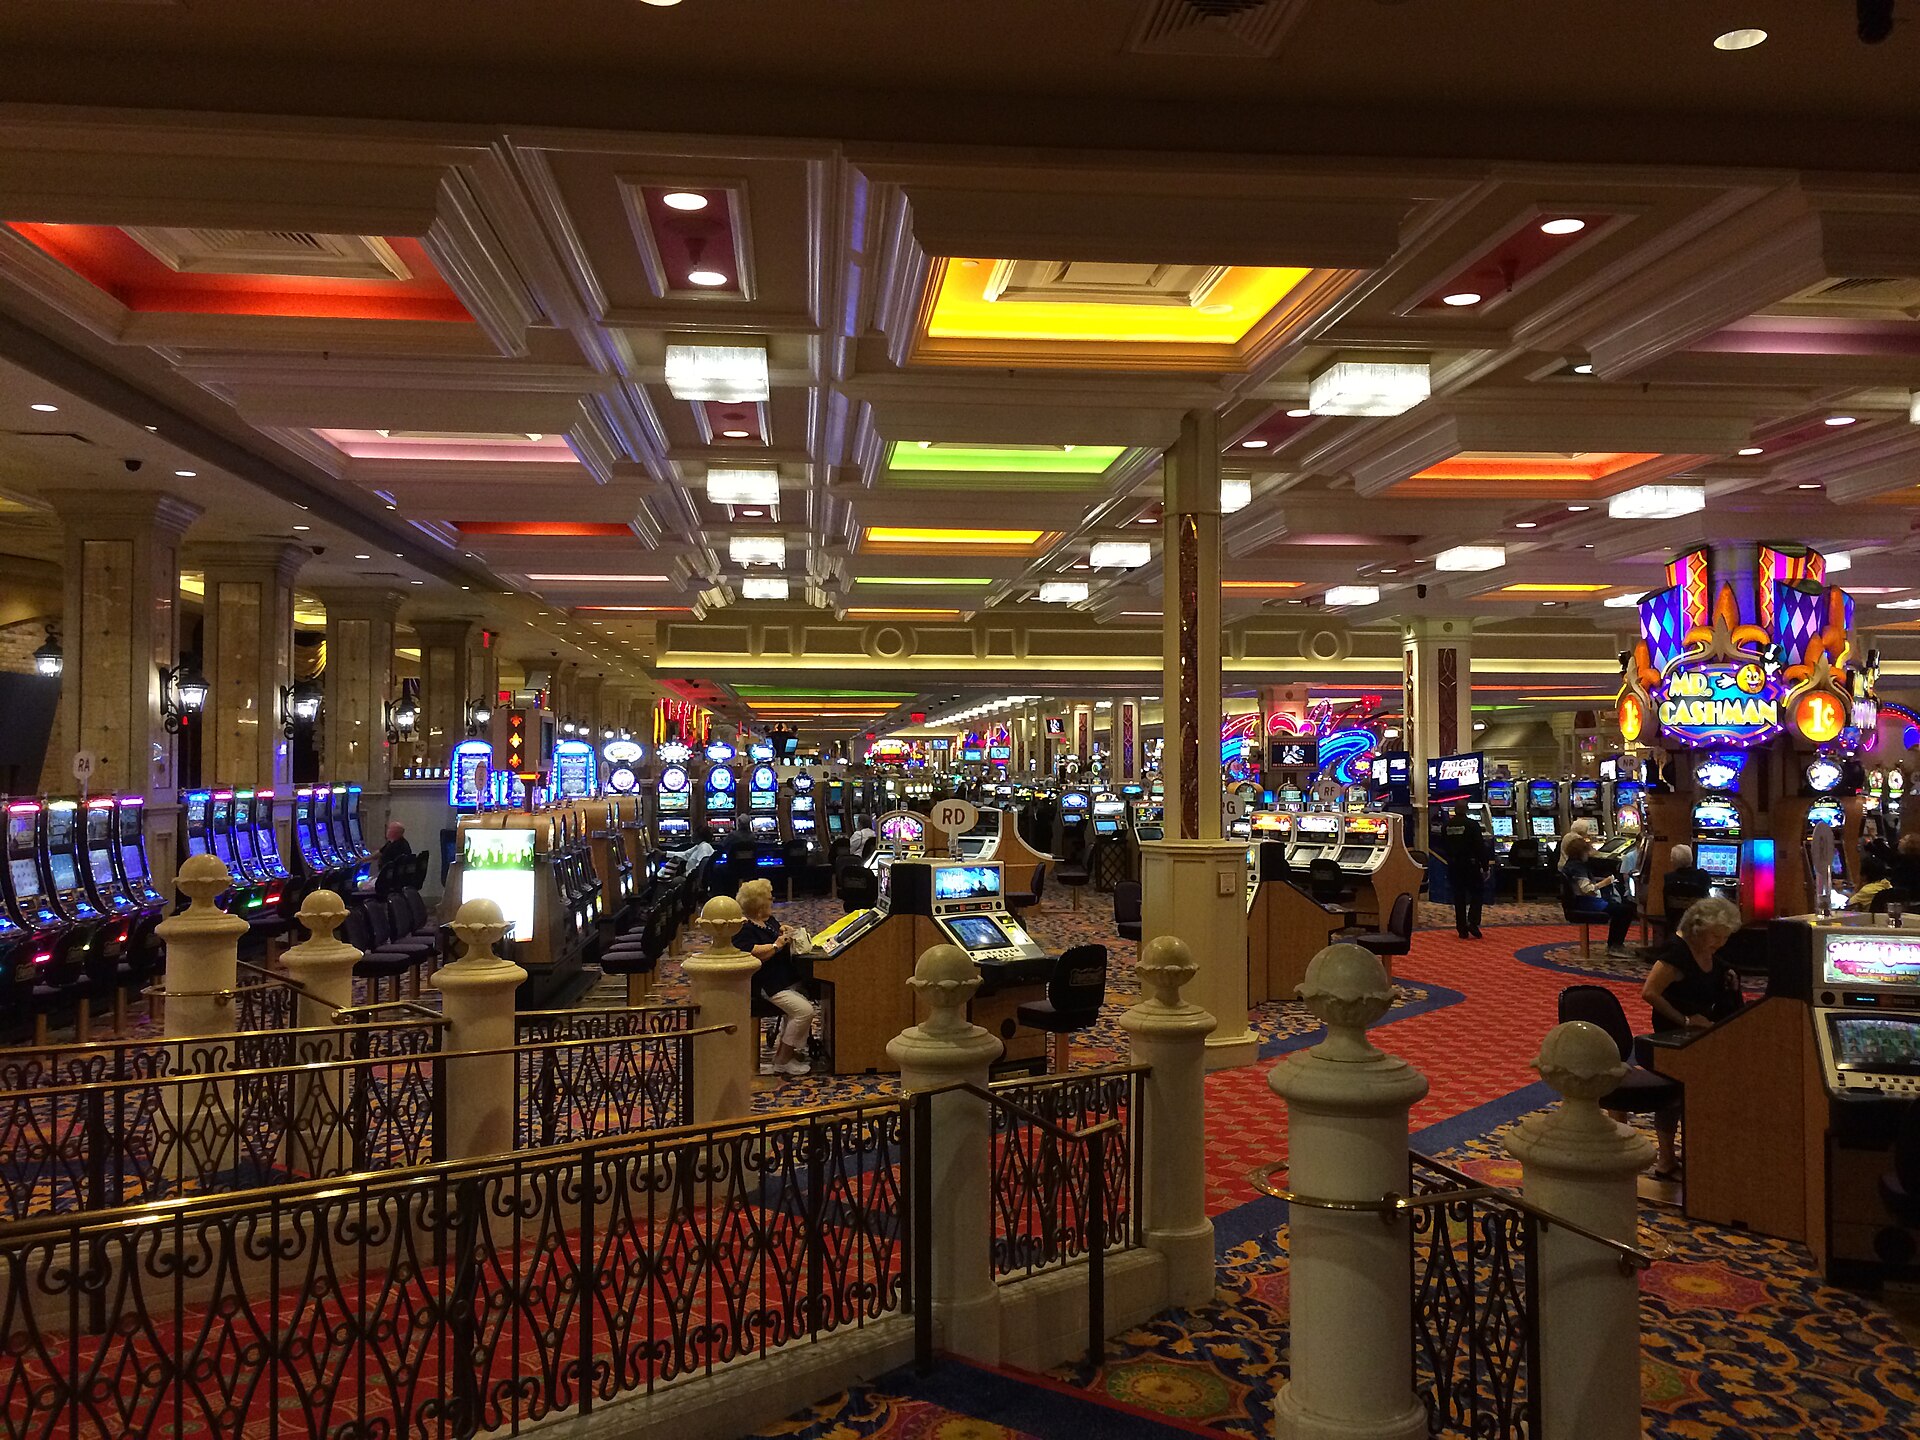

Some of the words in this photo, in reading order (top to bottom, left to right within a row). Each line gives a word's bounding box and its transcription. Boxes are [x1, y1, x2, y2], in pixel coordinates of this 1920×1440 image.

[1668, 671, 1714, 697] MR.
[1658, 698, 1778, 726] CASHMAN
[78, 758, 90, 772] RA
[1623, 759, 1635, 767] NR
[1323, 786, 1335, 796] RF
[1222, 801, 1236, 815] G
[942, 808, 965, 825] RD
